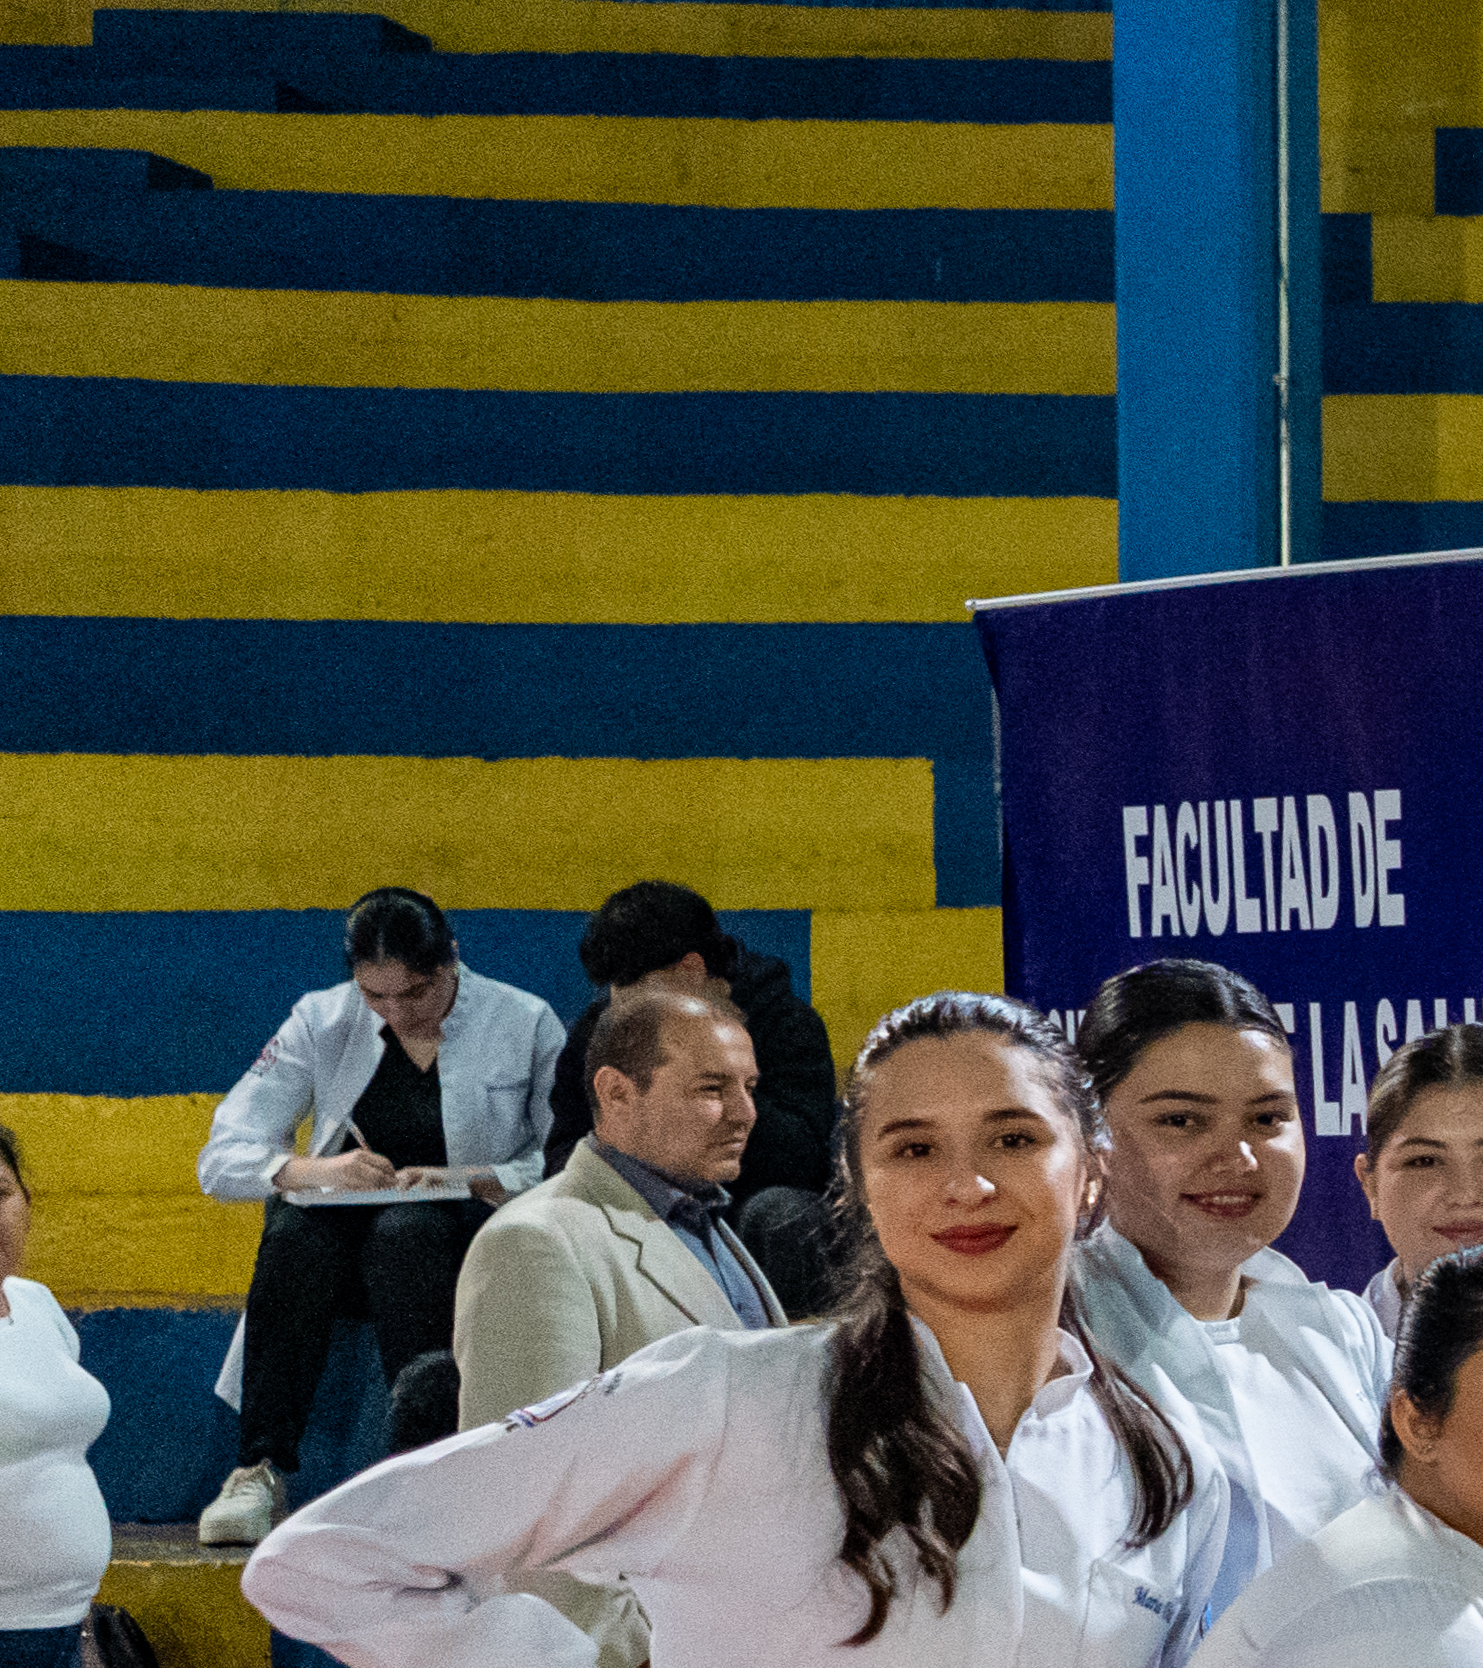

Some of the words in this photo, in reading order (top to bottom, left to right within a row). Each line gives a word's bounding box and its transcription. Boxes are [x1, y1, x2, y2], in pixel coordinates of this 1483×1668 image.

[1122, 794, 1340, 938] FACULTAD
[1348, 789, 1406, 929] DE
[1309, 1000, 1367, 1138] LA
